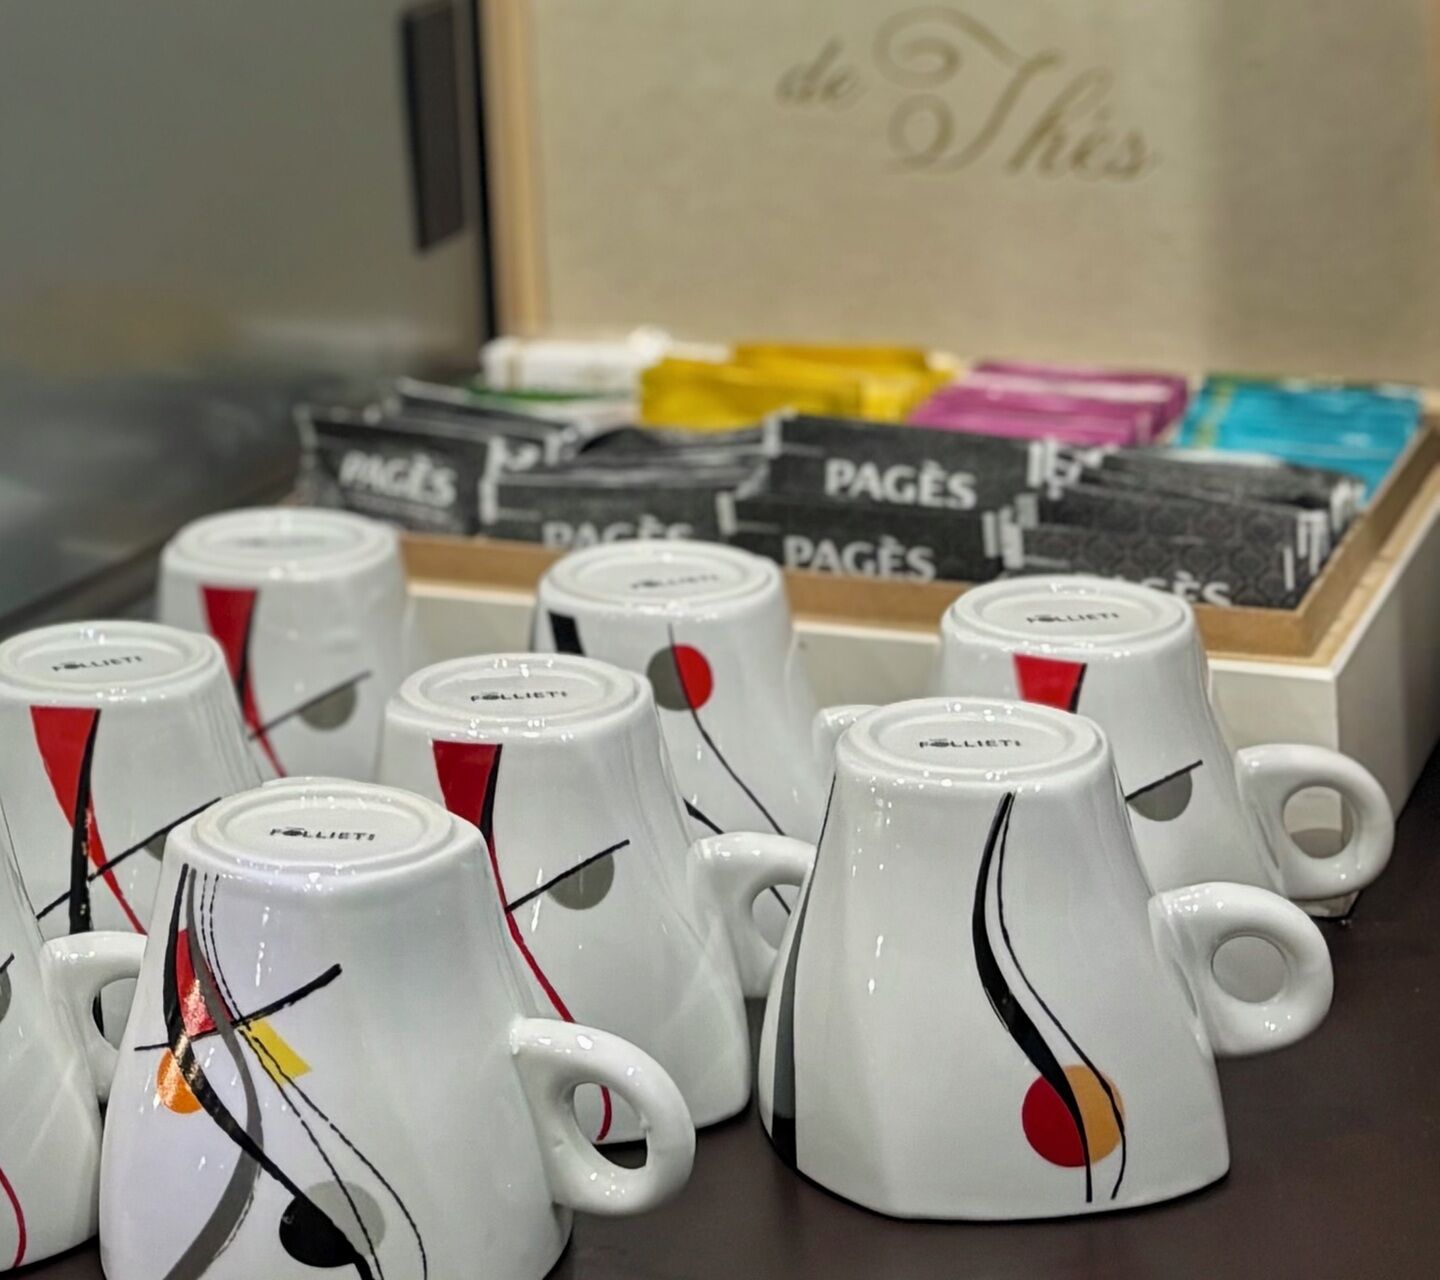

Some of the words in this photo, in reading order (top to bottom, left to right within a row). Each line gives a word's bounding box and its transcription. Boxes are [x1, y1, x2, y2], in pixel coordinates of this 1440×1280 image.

[774, 34, 864, 109] de
[824, 458, 977, 510] PAGÈS
[783, 535, 936, 580] PAGÈS
